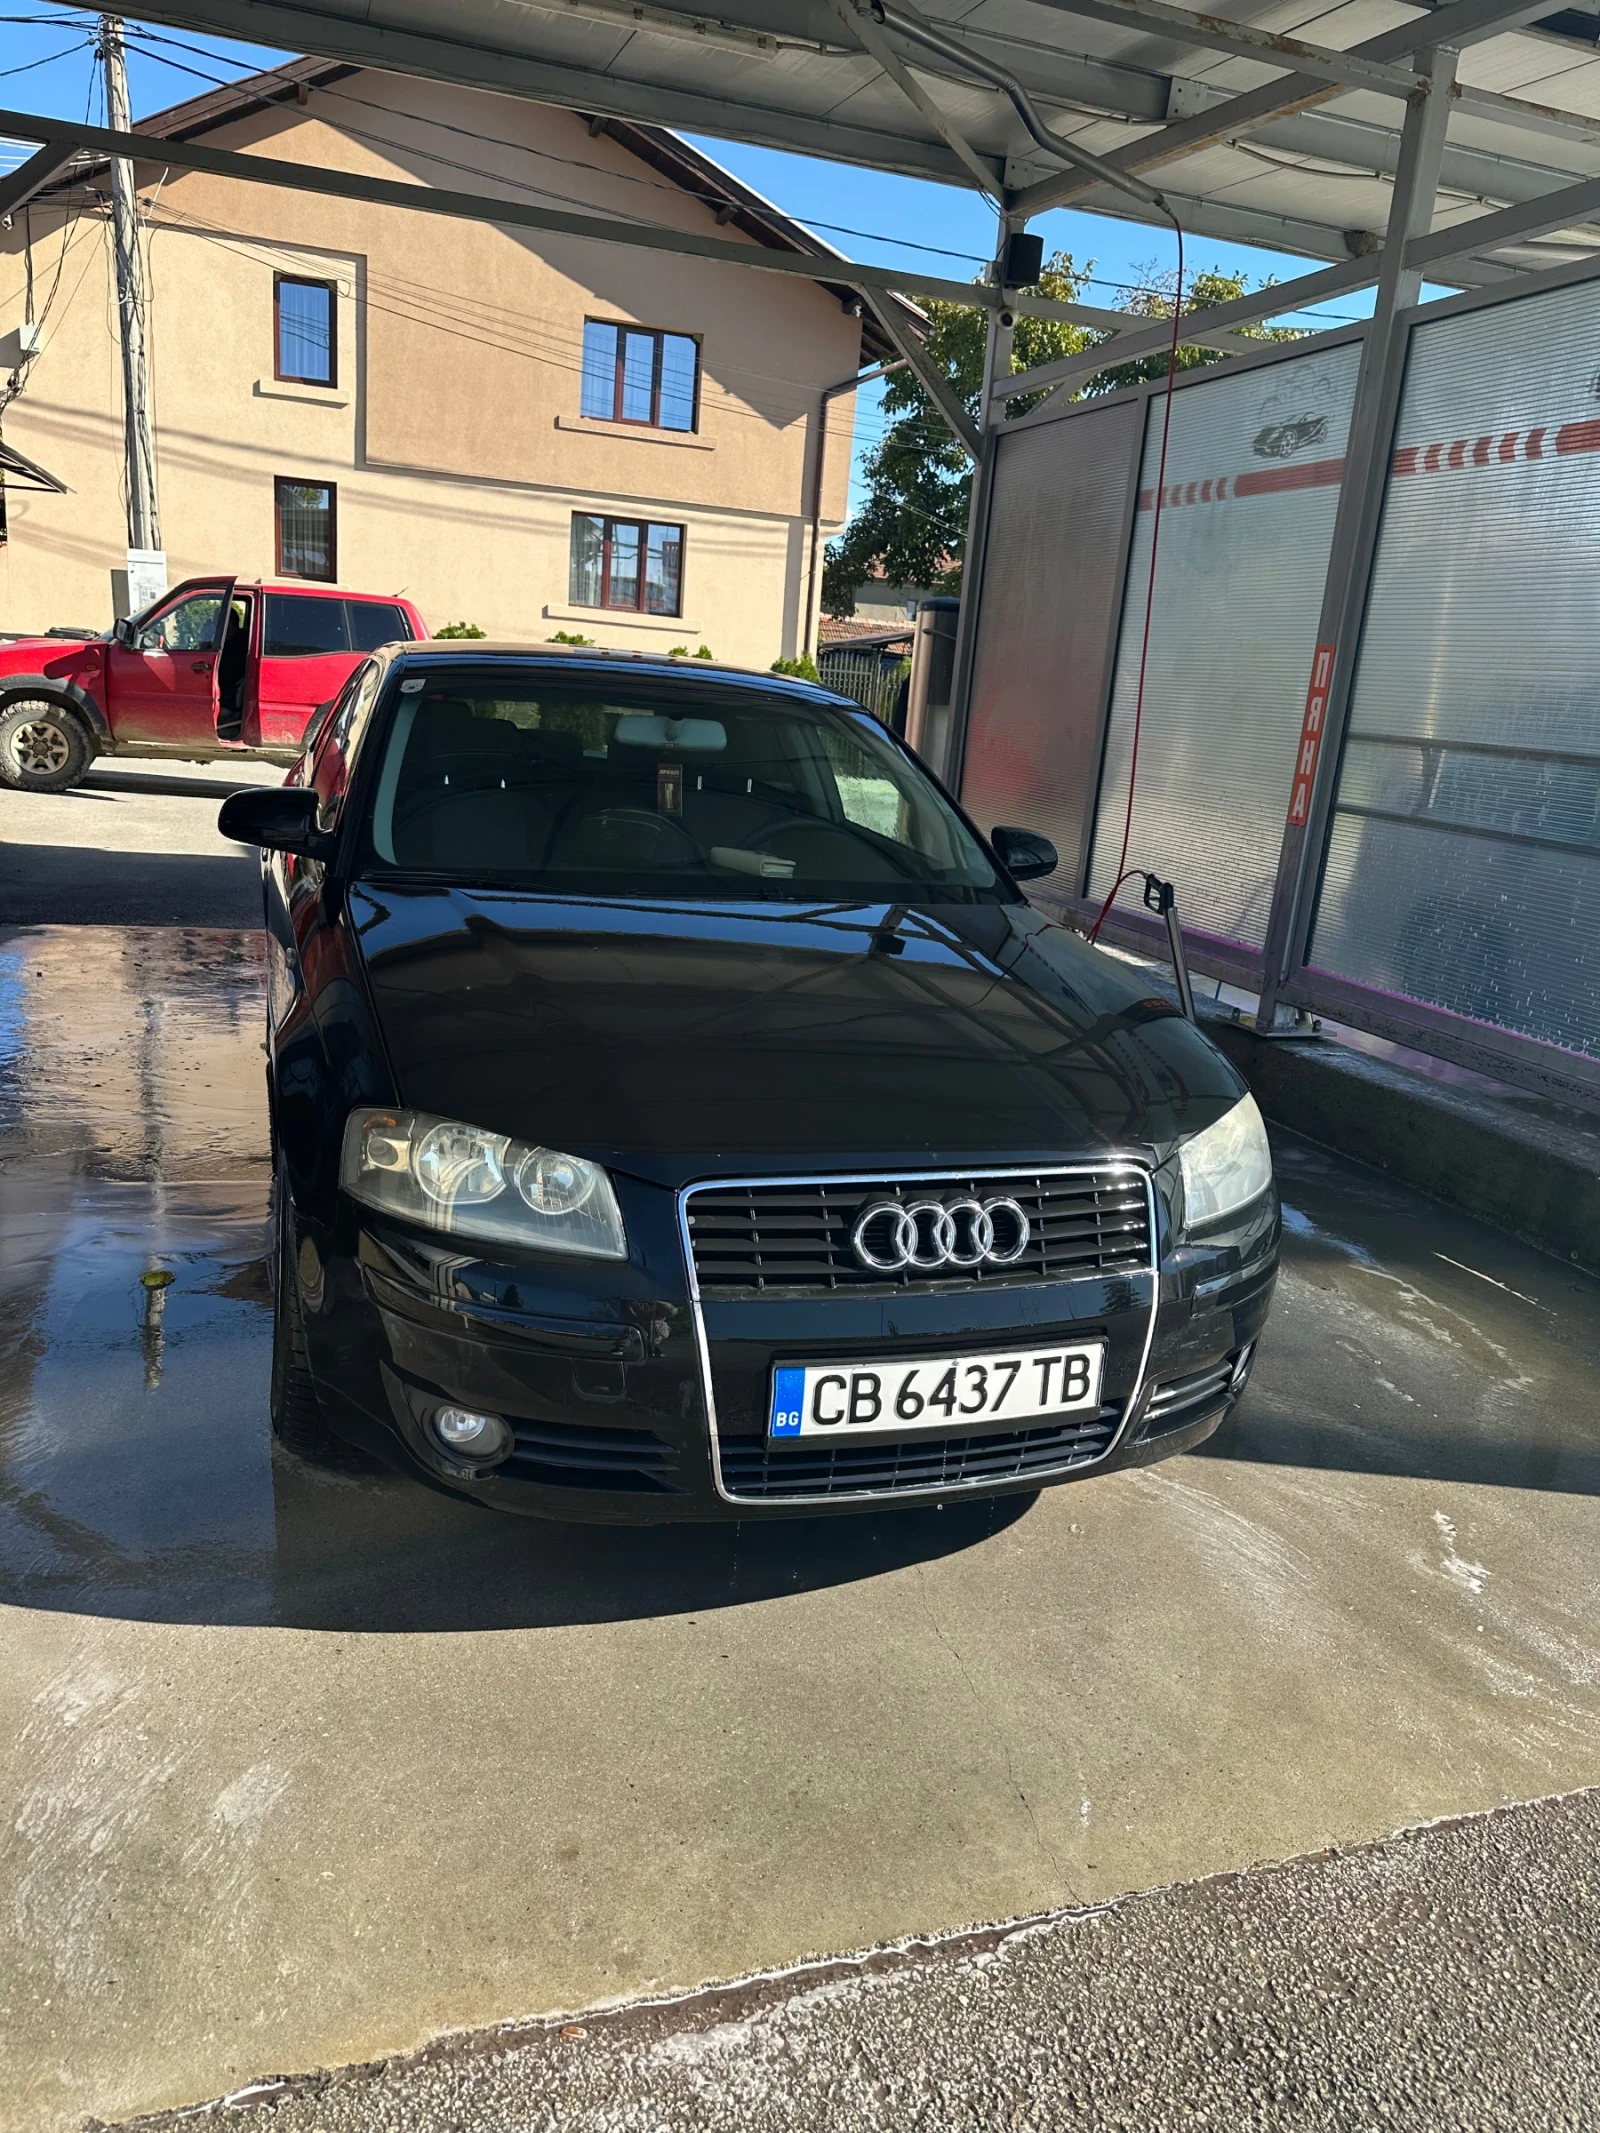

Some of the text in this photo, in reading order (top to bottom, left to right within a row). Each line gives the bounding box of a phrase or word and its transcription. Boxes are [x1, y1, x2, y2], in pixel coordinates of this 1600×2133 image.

[1291, 651, 1331, 818] ПЯНА
[776, 1411, 800, 1427] BG
[812, 1353, 1091, 1426] CB 6437 TB
